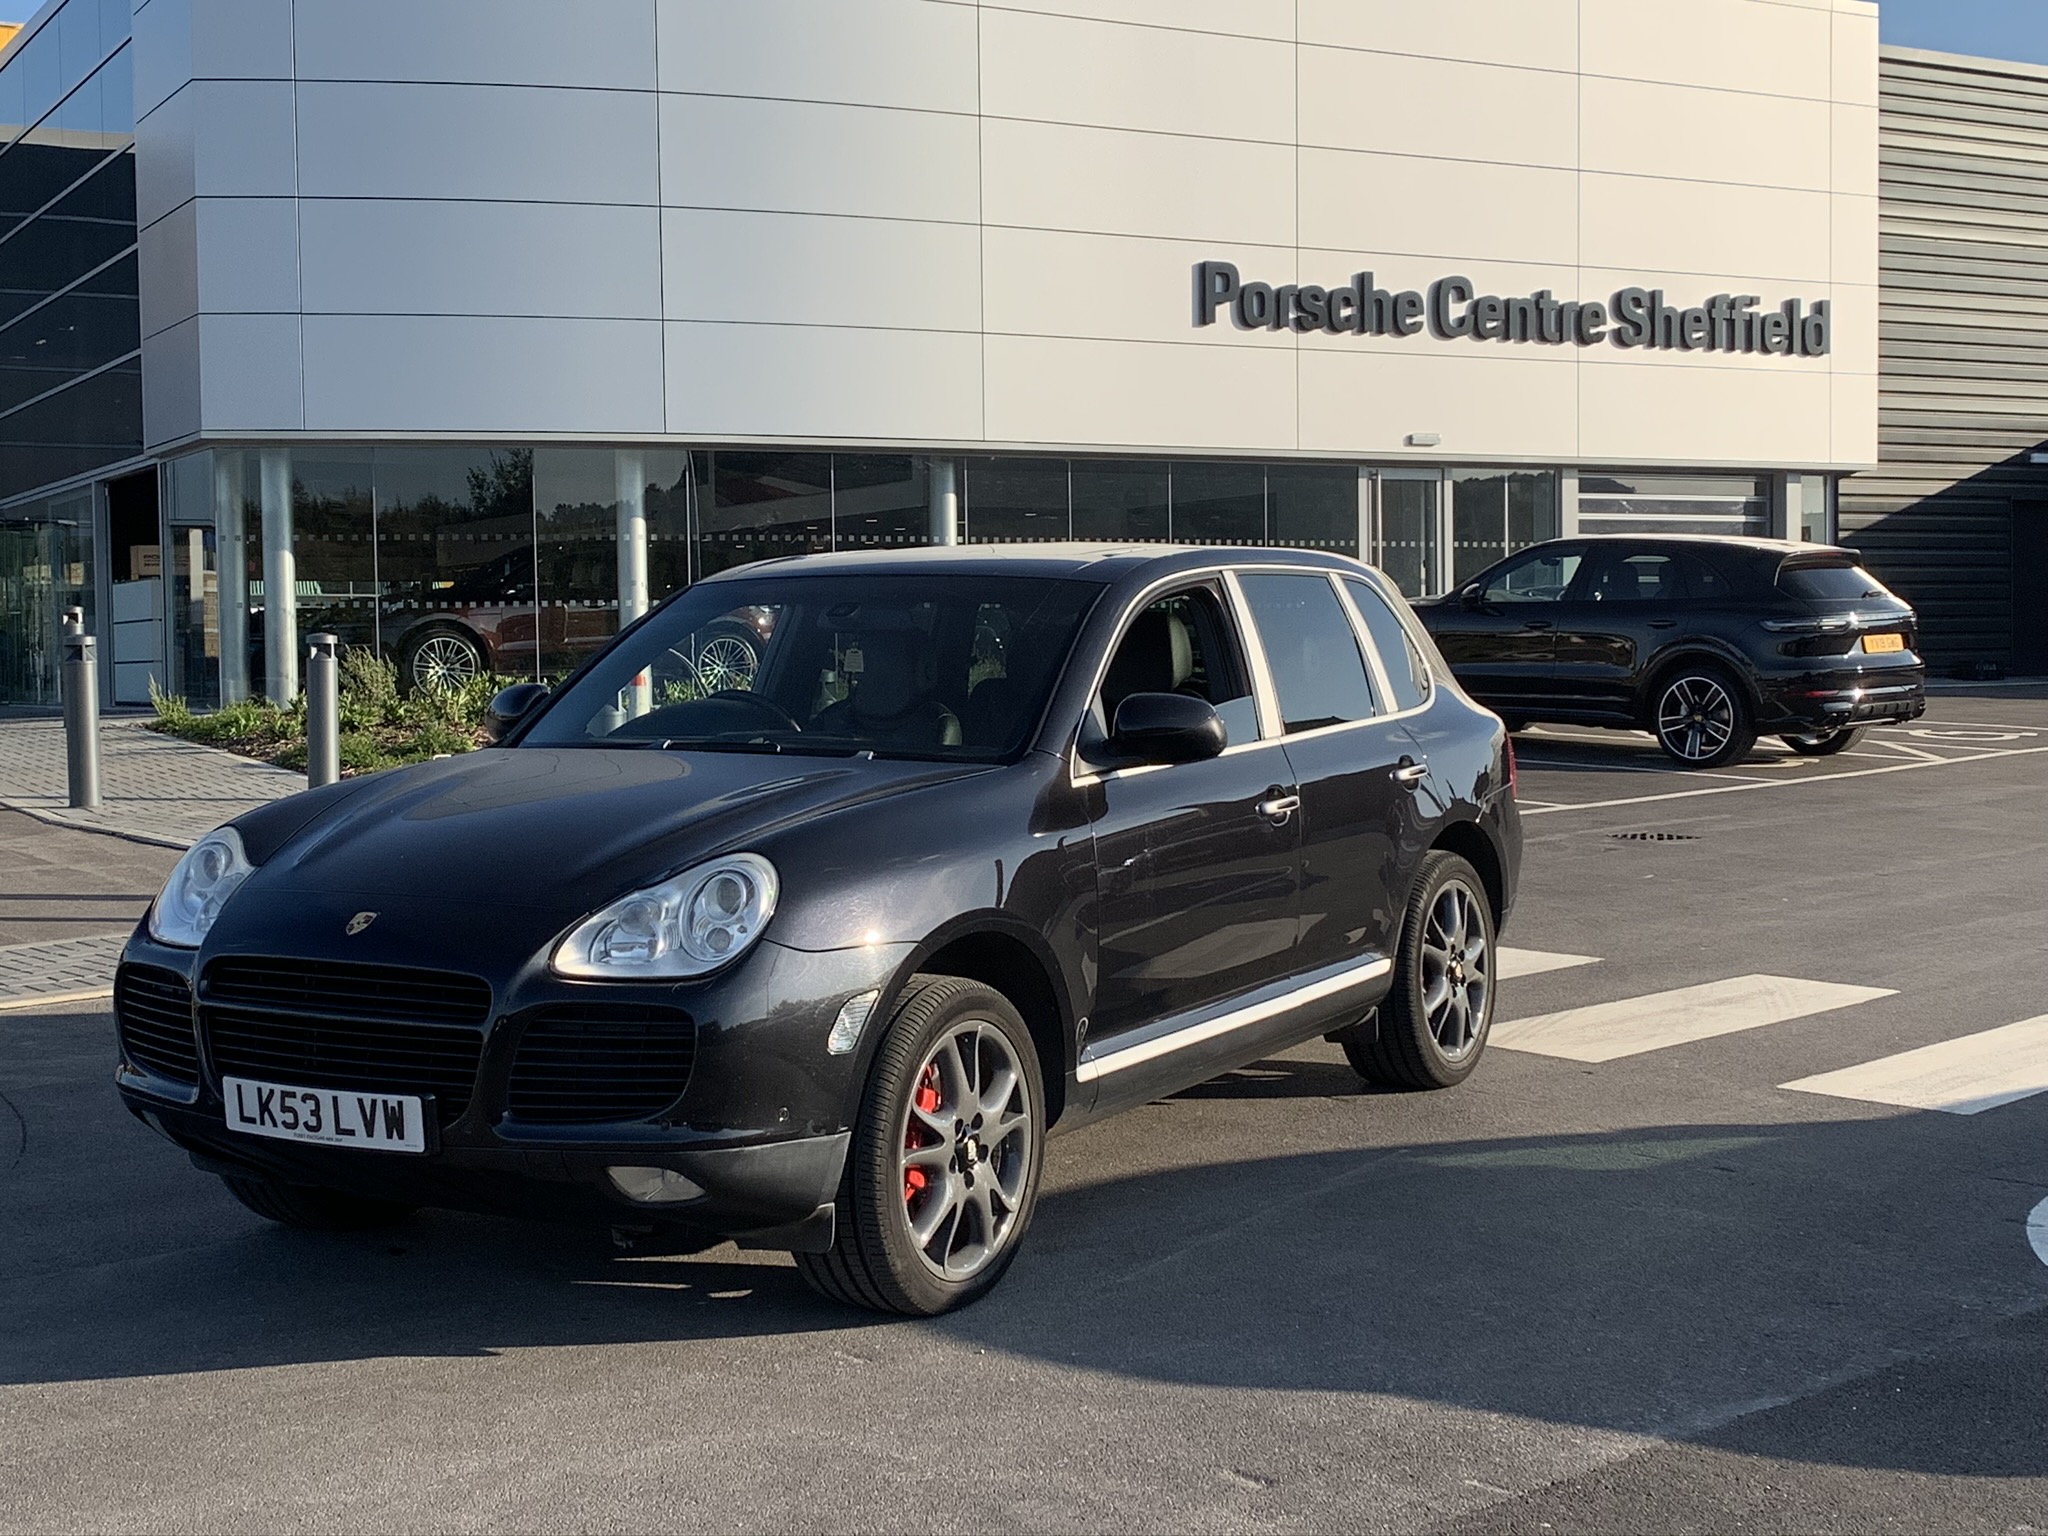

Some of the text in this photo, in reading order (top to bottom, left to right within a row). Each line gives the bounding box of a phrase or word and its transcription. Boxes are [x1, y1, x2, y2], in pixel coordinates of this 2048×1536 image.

[1192, 260, 1831, 358] Porsche Centre Sheffield
[236, 1083, 405, 1141] LK53 LVW
